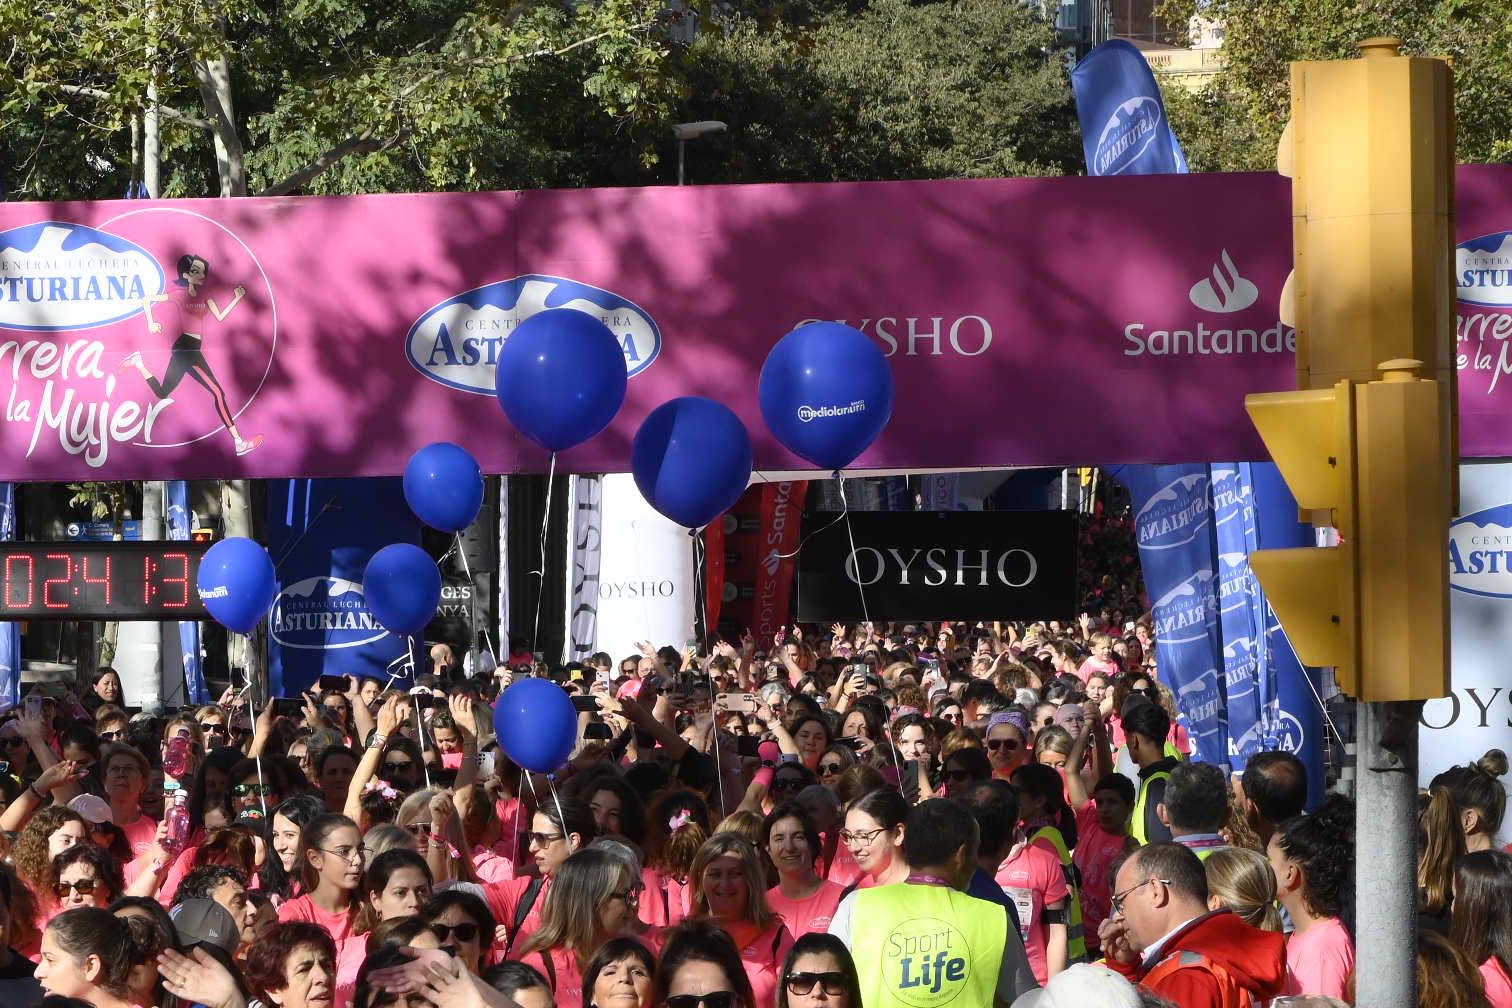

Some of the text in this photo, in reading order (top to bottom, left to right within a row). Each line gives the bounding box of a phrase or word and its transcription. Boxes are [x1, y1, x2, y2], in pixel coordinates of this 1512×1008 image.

[465, 319, 522, 330] CENTR
[793, 315, 993, 357] SHO
[1474, 341, 1492, 370] la
[6, 384, 31, 422] la
[25, 374, 175, 468] Mujer
[797, 404, 866, 422] mediolanum
[5, 553, 206, 608] 02:41:3
[844, 546, 1038, 588] OYSHO
[599, 579, 675, 600] OYSHO
[888, 927, 953, 958] Sport
[899, 950, 966, 993] Life
